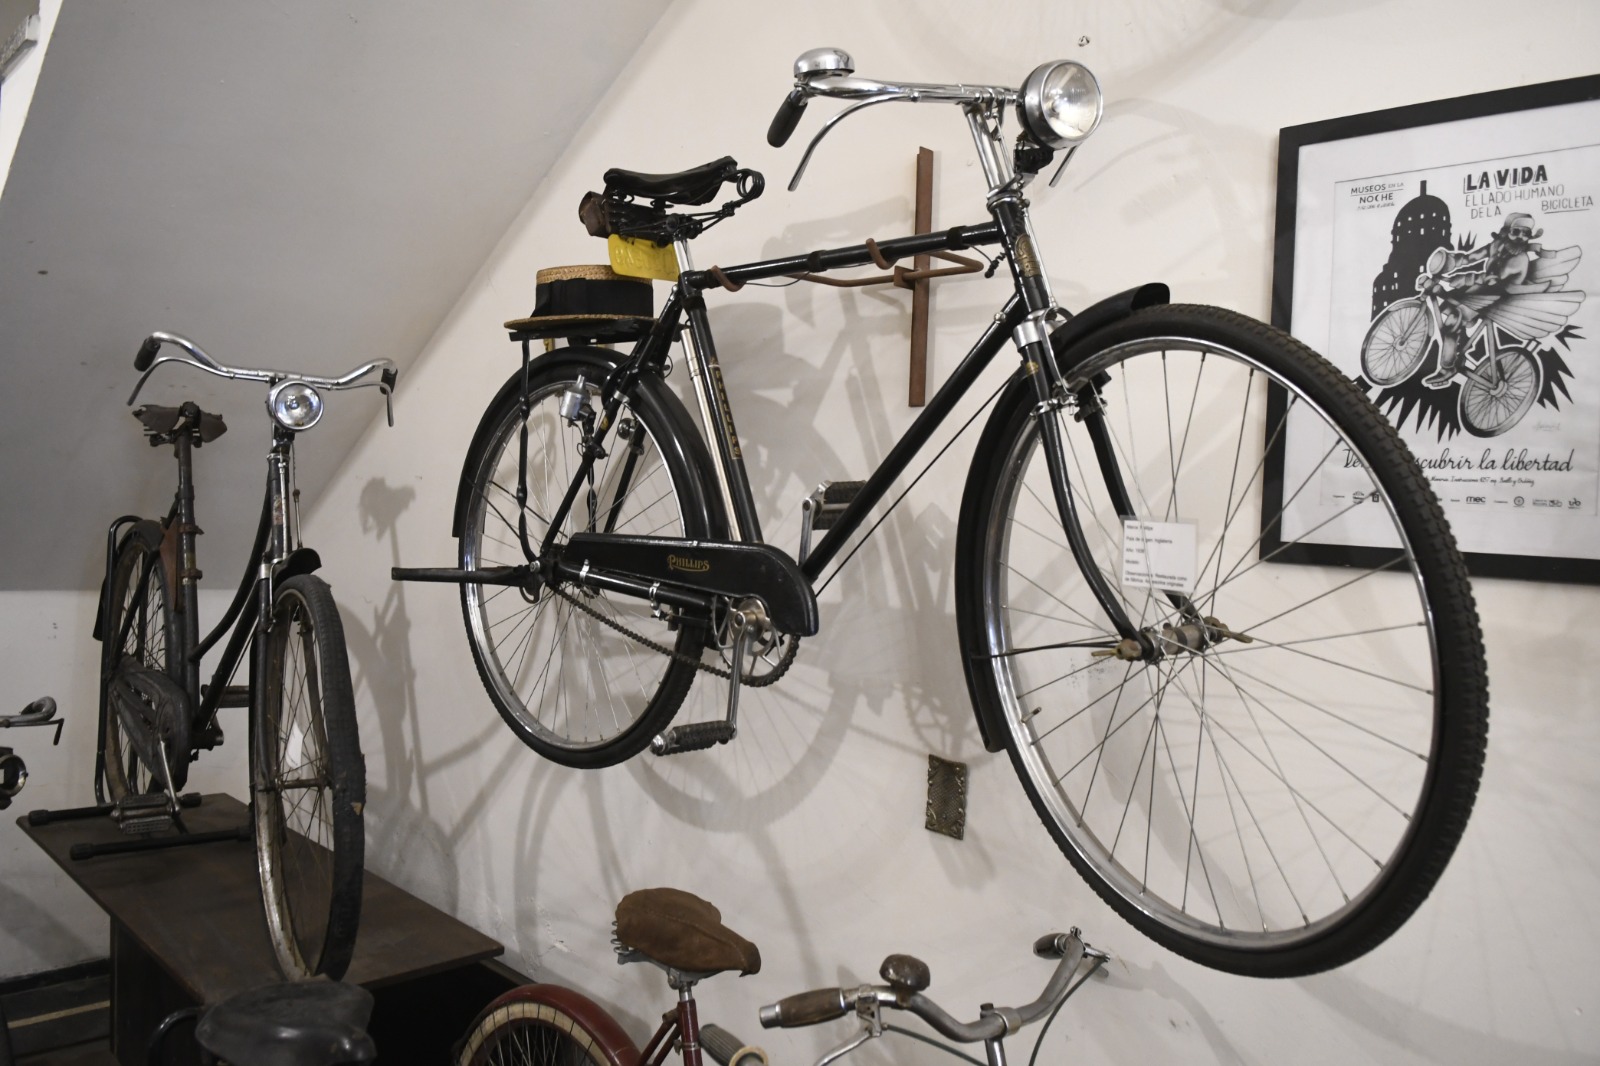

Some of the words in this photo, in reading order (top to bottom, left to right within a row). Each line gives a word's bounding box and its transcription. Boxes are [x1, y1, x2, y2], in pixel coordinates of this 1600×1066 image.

[1351, 184, 1386, 194] MUSEOS
[1463, 171, 1491, 194] LA
[1494, 164, 1549, 189] VIDA
[1359, 192, 1394, 204] NOCHE
[1465, 193, 1479, 207] EL
[1481, 191, 1512, 206] LADO
[1514, 183, 1565, 201] HUMANO
[1470, 207, 1484, 220] DE
[1486, 205, 1502, 218] LA
[1541, 195, 1594, 212] BICICLETA
[1477, 448, 1497, 471] la
[1500, 448, 1575, 472] libertad
[667, 554, 710, 571] PHILLIPS
